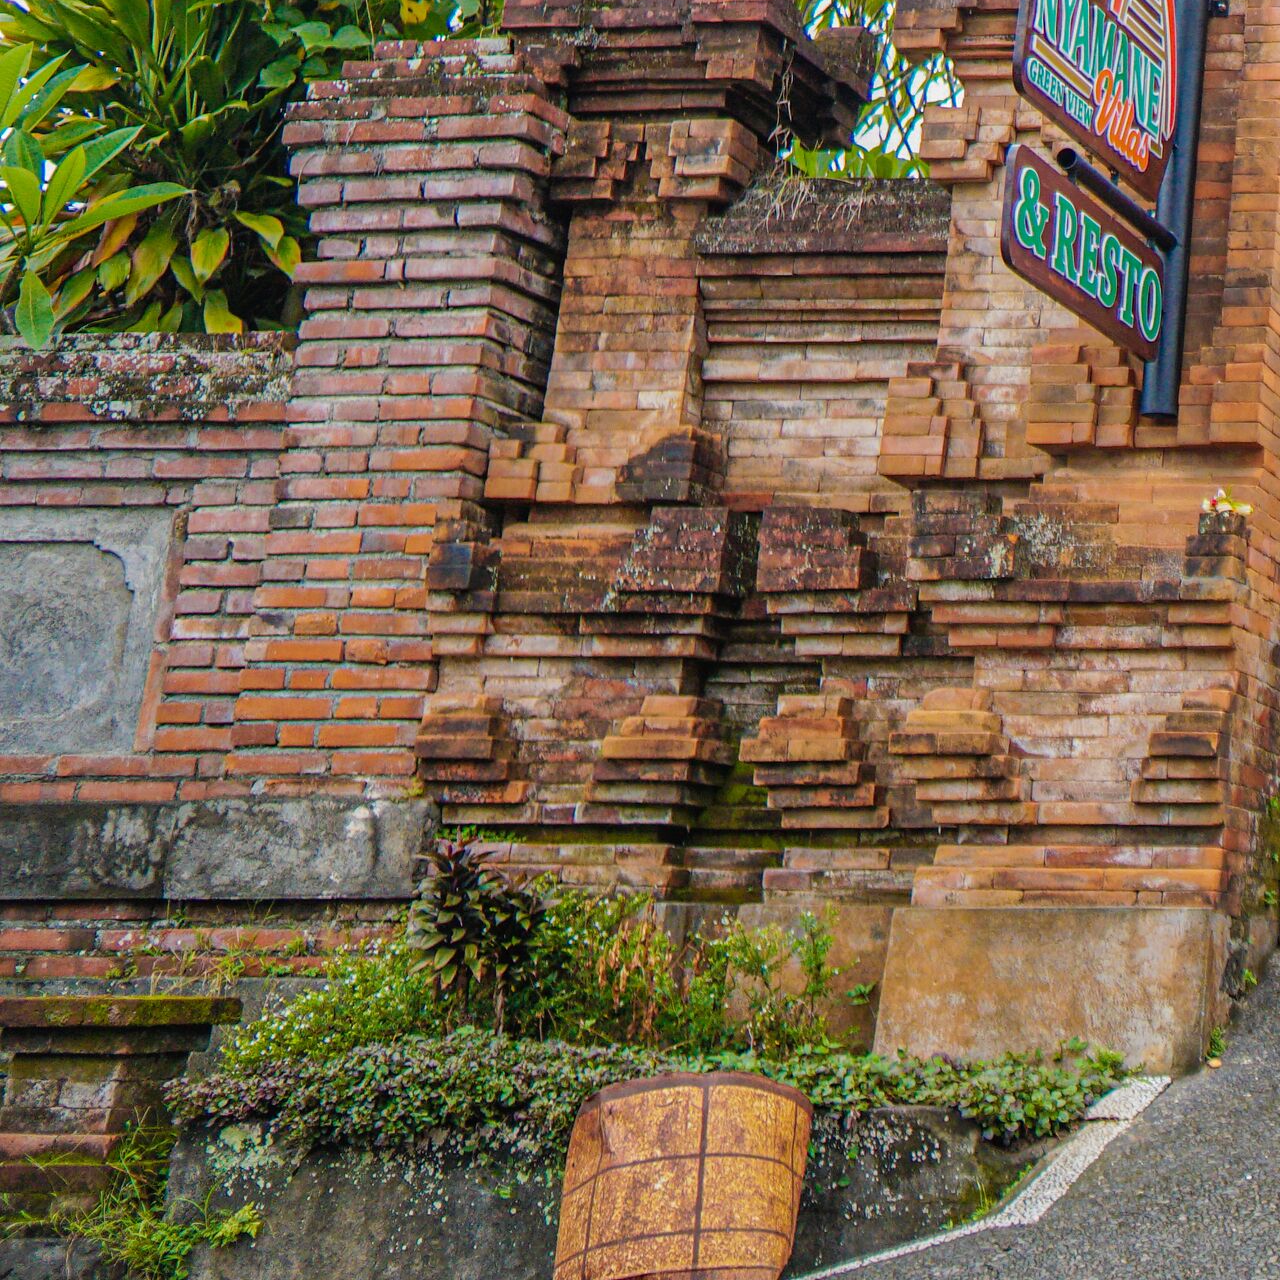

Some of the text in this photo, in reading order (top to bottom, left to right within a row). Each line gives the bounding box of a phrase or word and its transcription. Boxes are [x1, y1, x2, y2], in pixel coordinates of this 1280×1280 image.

[1027, 58, 1094, 132] GREEN VIEW
[1094, 68, 1150, 173] Villas
[1014, 167, 1163, 342] & RESTO
